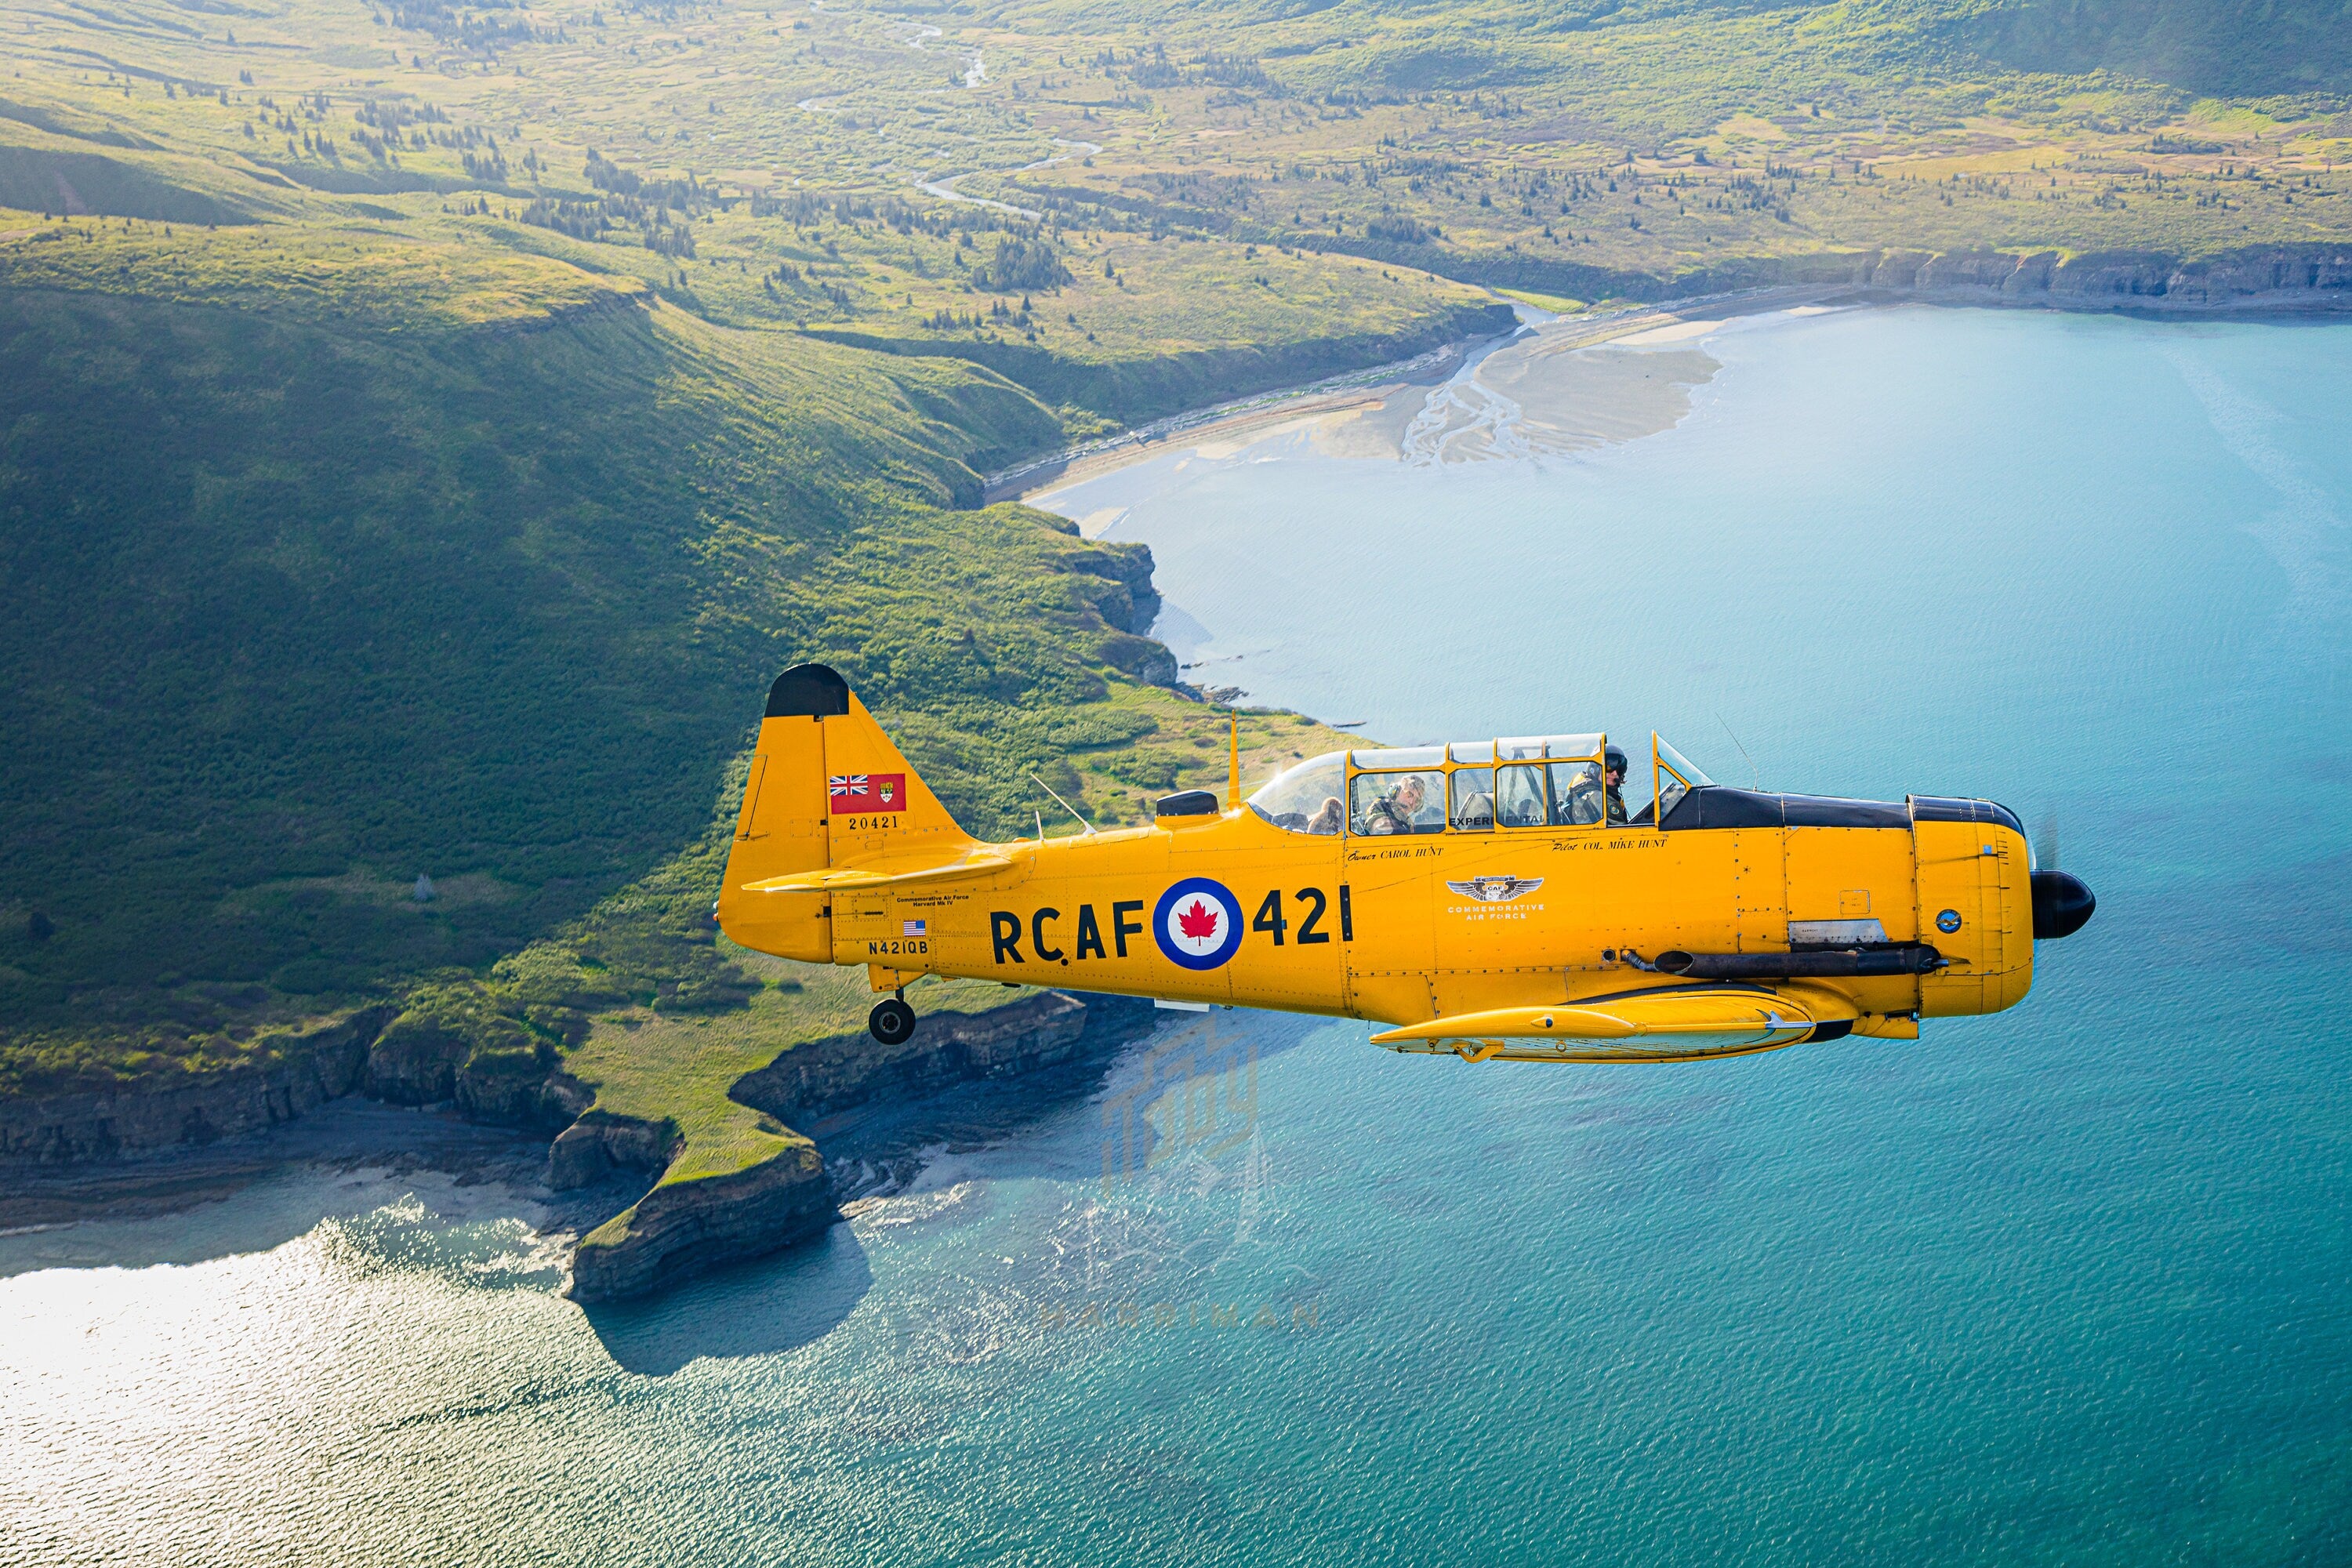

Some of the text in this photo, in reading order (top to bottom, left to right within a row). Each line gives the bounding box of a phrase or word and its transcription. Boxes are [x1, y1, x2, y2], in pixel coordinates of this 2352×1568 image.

[849, 815, 898, 830] 20421
[1449, 815, 1550, 826] EXPERIENTAL
[1552, 842, 1578, 851] Pilot
[1608, 840, 1635, 849] MIKE
[1638, 839, 1668, 848] HUNT
[1348, 848, 1444, 862] Owner CAROL HUNT
[1447, 904, 1544, 913] COMMEMORATIVE
[990, 884, 1353, 964] RCAF 421
[869, 941, 928, 955] N421QB
